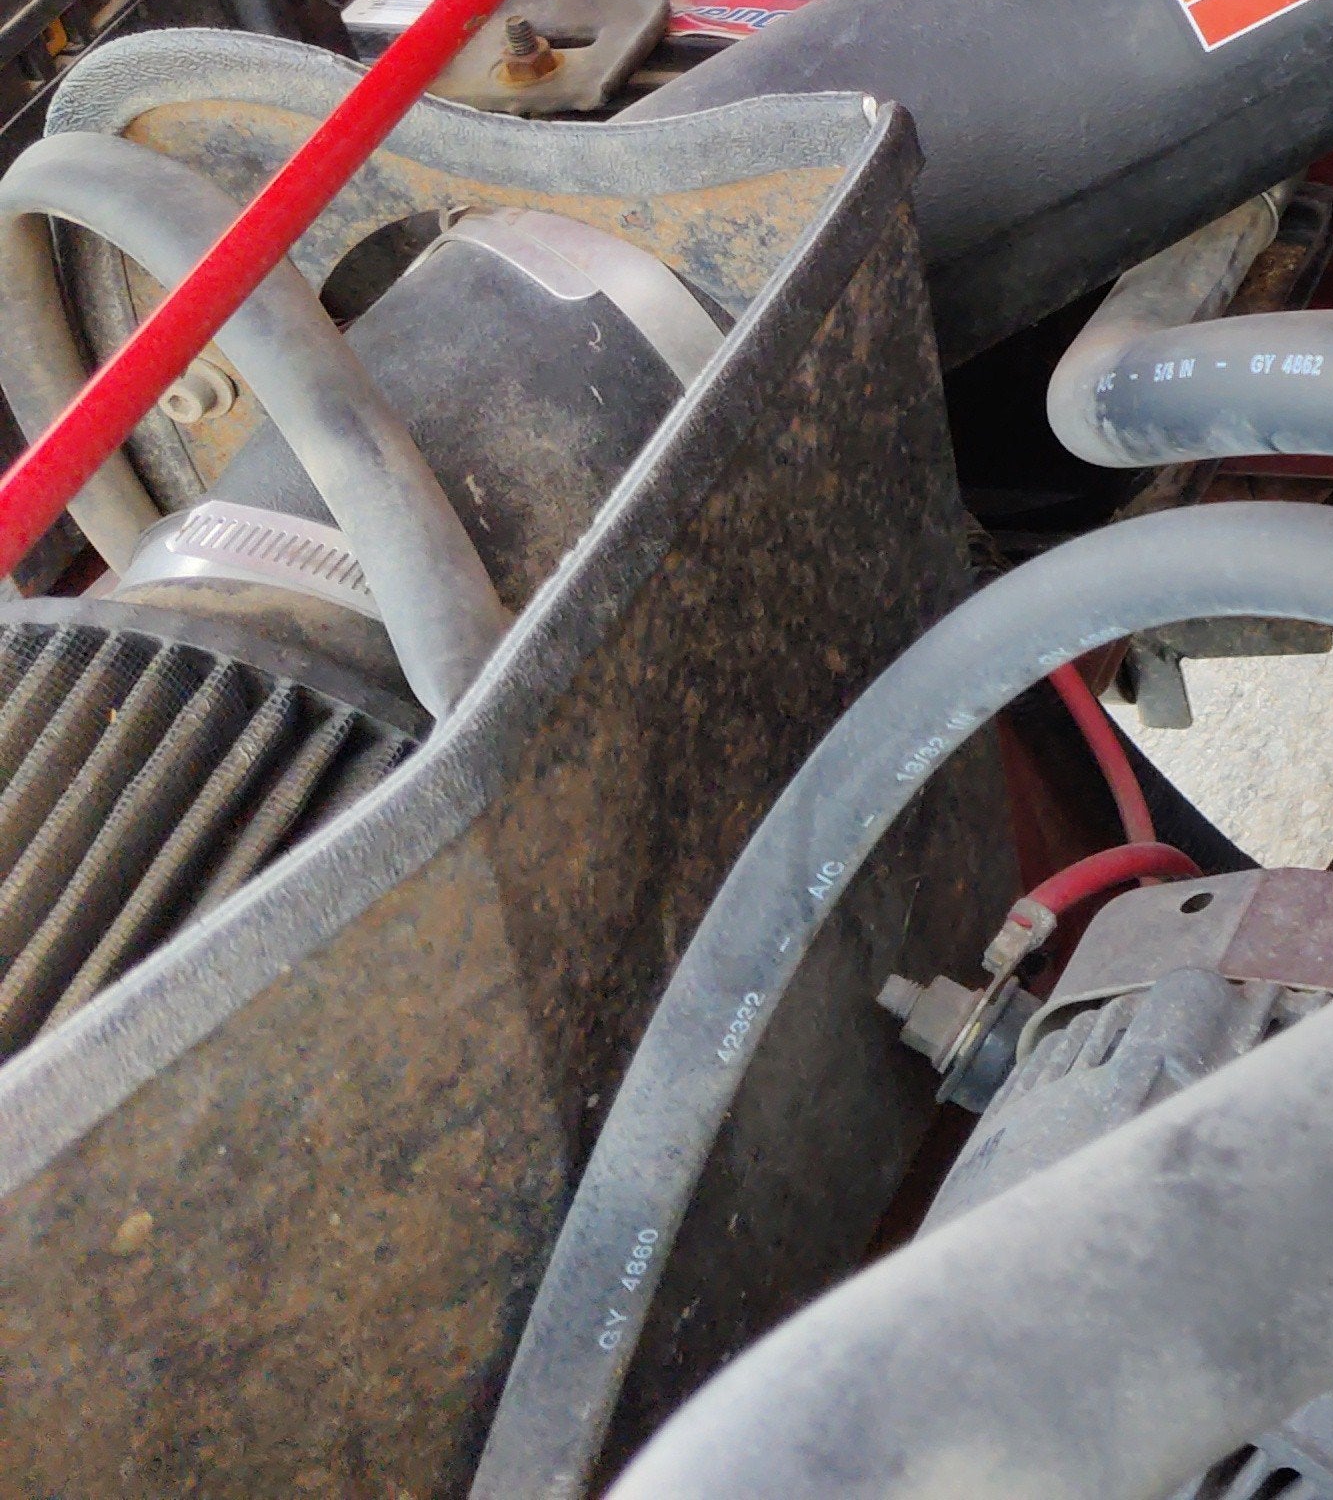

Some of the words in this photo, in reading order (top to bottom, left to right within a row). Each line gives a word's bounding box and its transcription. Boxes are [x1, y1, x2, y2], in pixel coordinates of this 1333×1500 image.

[1249, 354, 1277, 374] GY
[598, 1306, 628, 1351] GY
[619, 1227, 660, 1294] 4860
[806, 860, 847, 901] A/C
